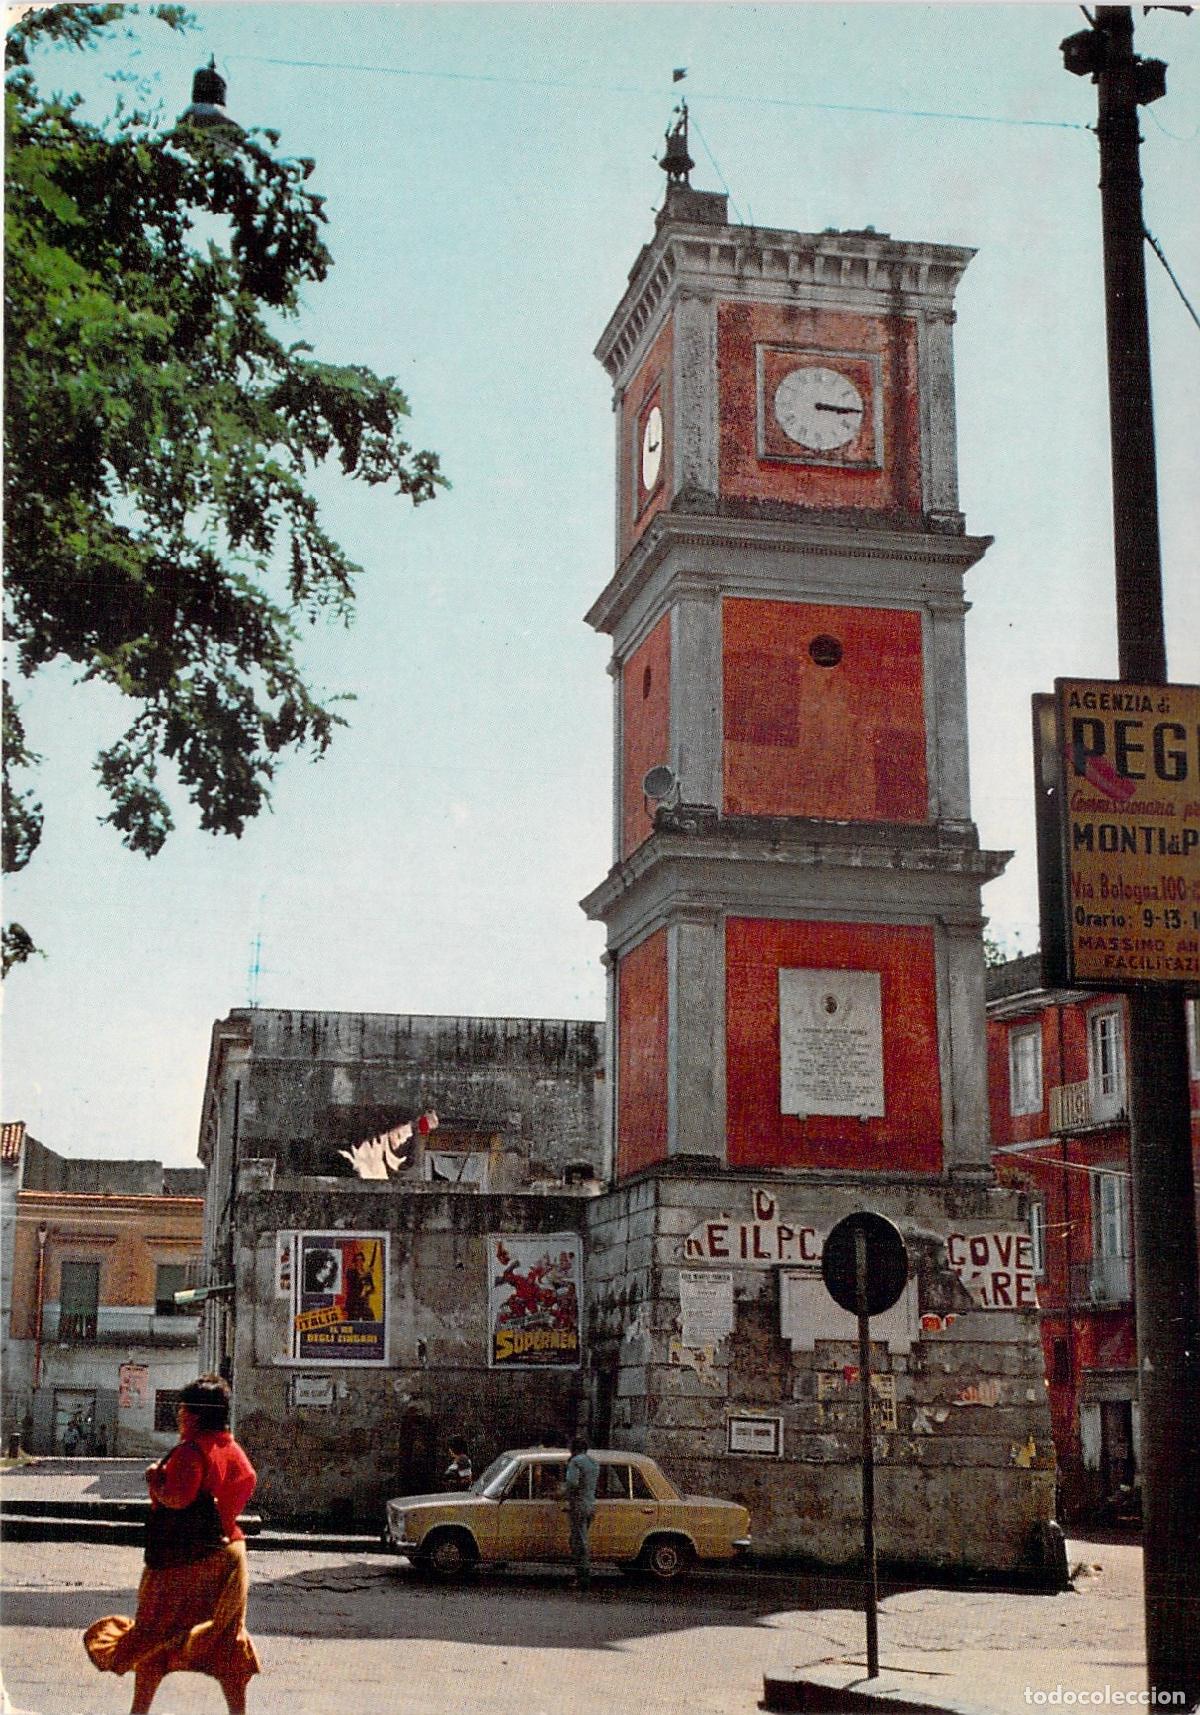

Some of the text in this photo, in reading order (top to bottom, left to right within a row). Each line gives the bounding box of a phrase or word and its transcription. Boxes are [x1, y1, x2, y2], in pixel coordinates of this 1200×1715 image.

[1069, 691, 1153, 713] AGENZIA
[1072, 717, 1200, 782] PEG
[1073, 822, 1166, 855] MONTI
[1072, 871, 1093, 898] Via
[1074, 905, 1133, 928] Orario:
[1078, 936, 1165, 952] MASSIMO
[298, 1312, 339, 1330] ITALIA
